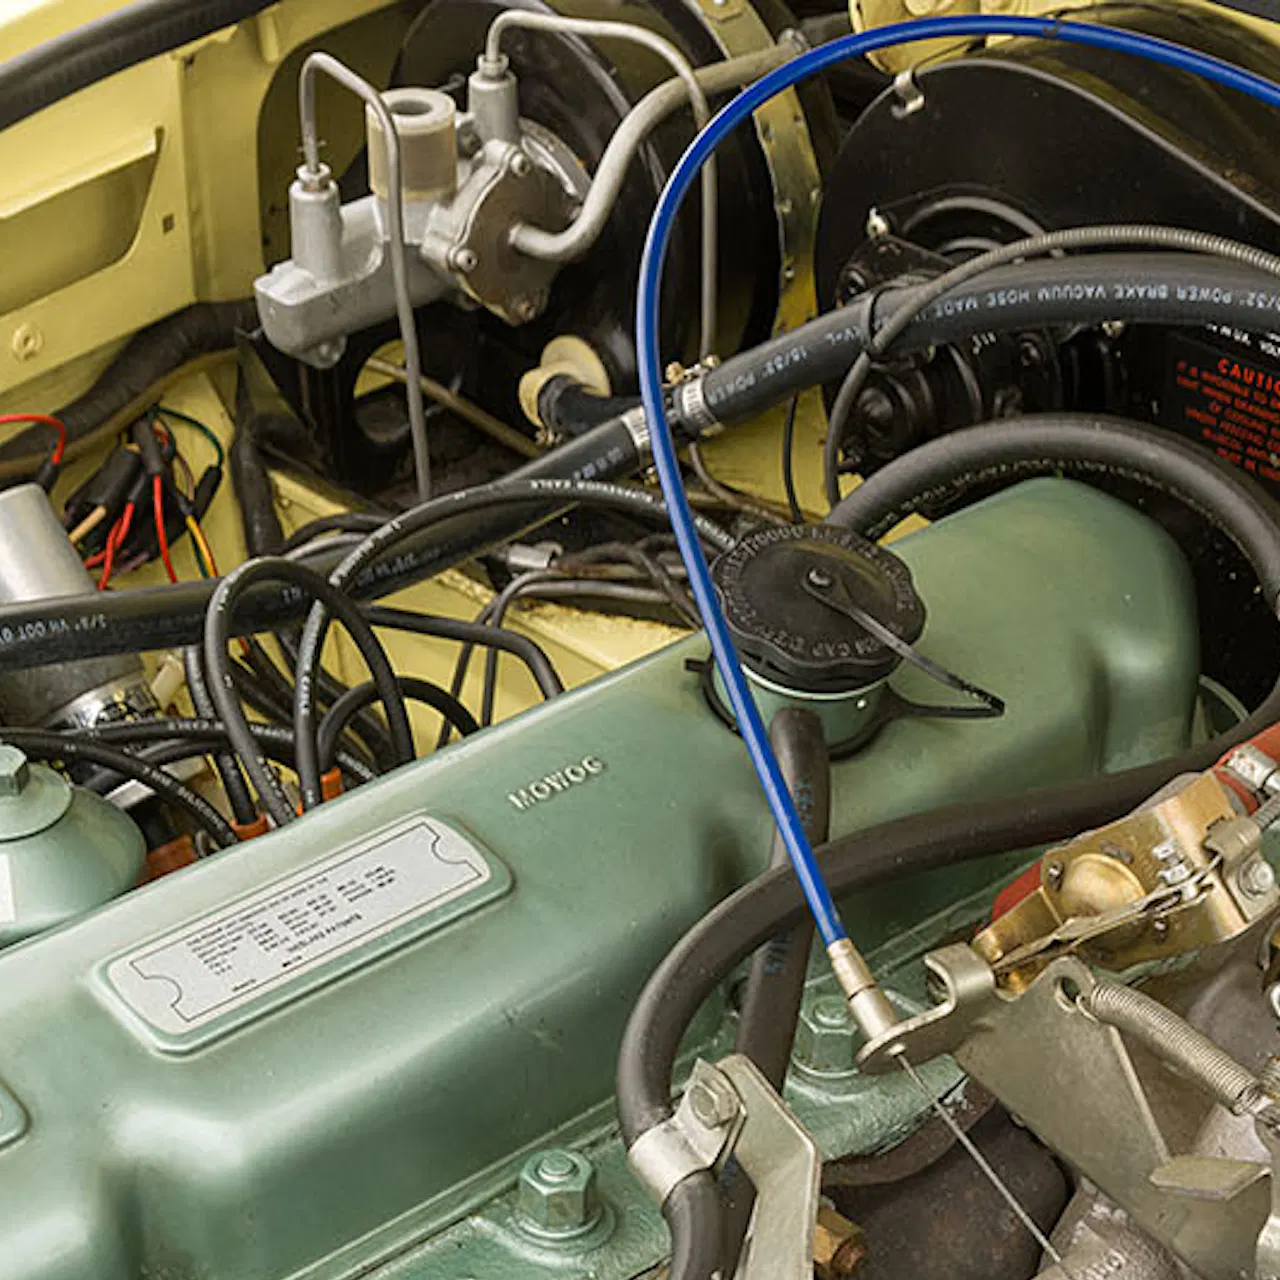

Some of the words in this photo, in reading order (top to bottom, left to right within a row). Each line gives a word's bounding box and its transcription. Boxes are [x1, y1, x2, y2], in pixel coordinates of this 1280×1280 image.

[987, 288, 1030, 307] HOSE
[1037, 284, 1106, 301] VACUUM
[1113, 283, 1169, 299] BRAKE
[1176, 284, 1233, 304] POWER
[935, 296, 979, 317] MADE
[507, 755, 605, 811] MOWOG
